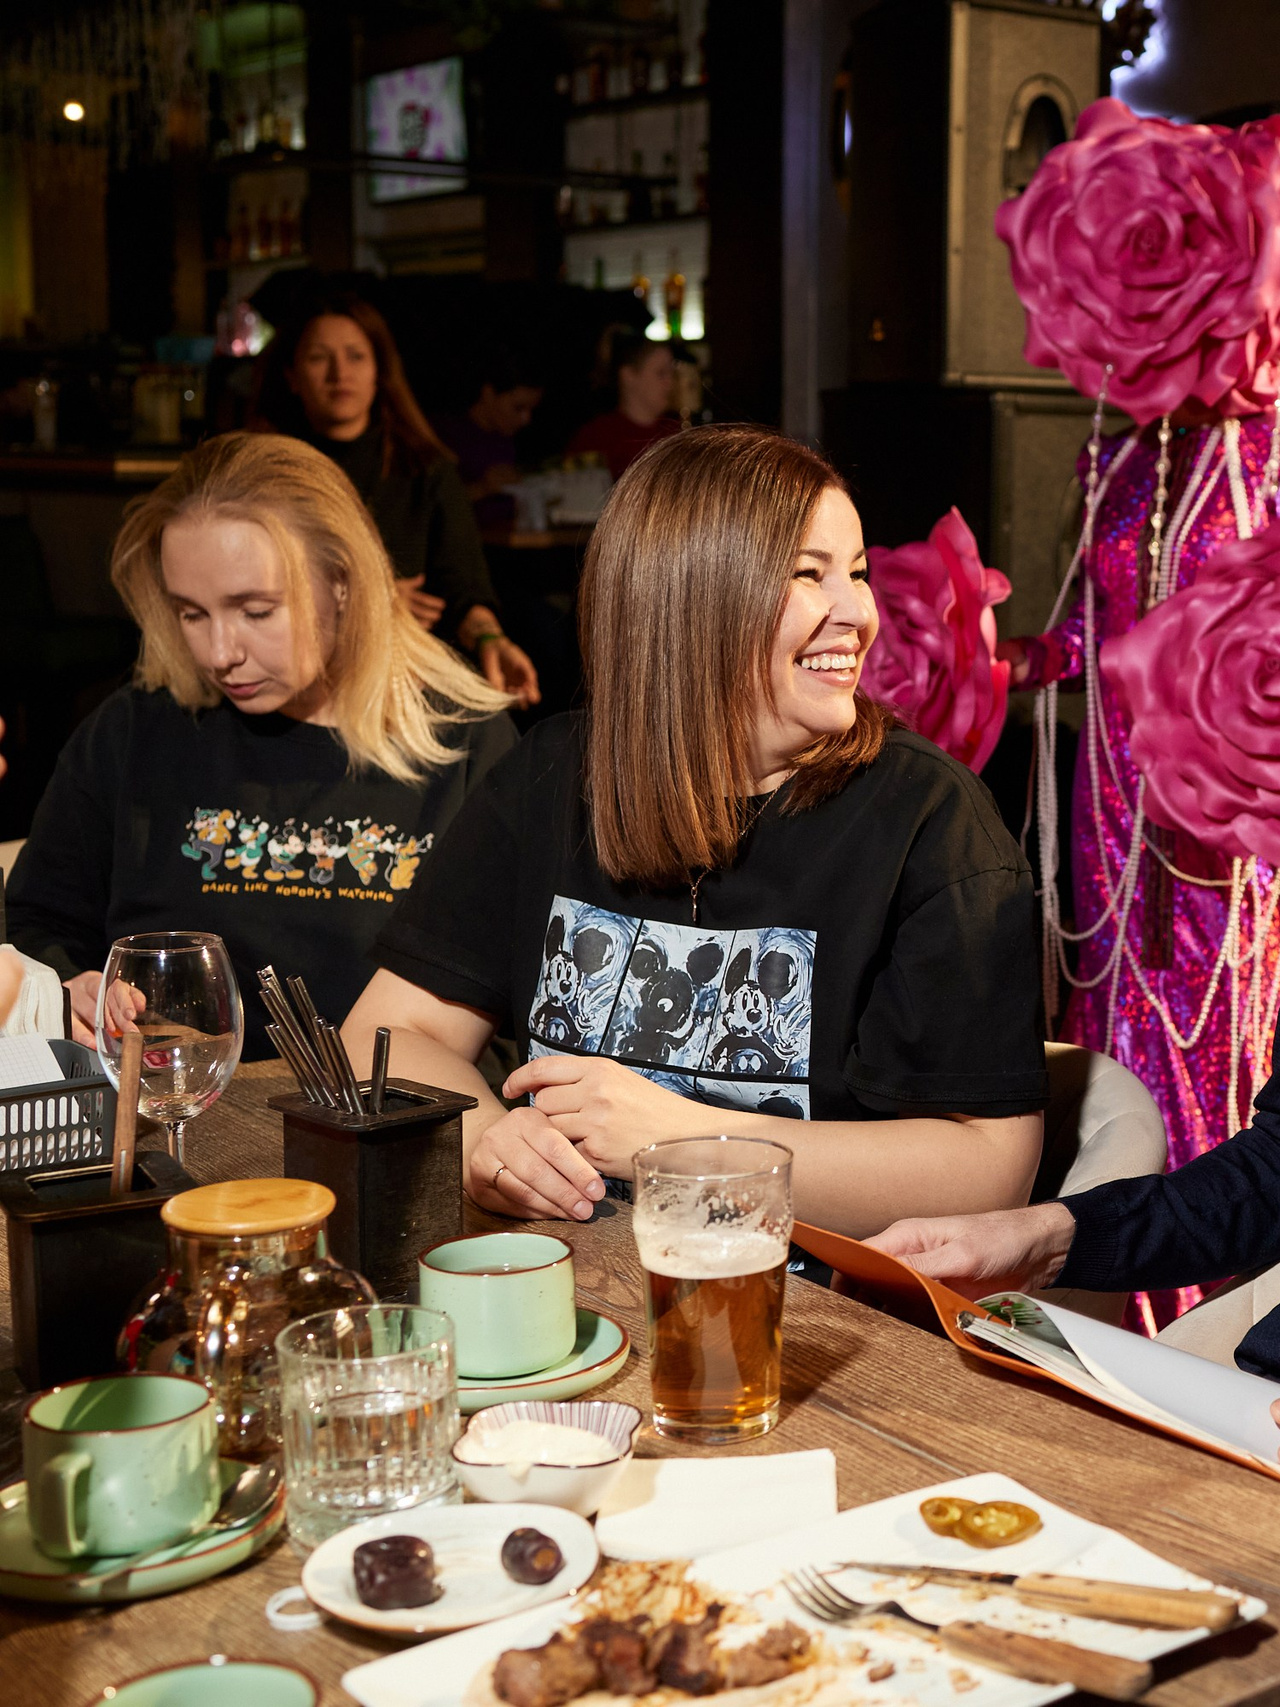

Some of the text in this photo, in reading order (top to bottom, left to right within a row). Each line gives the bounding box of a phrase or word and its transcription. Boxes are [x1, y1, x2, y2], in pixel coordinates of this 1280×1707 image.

[202, 881, 394, 903] DANCE LIKE NOBODY'S WATCHING
